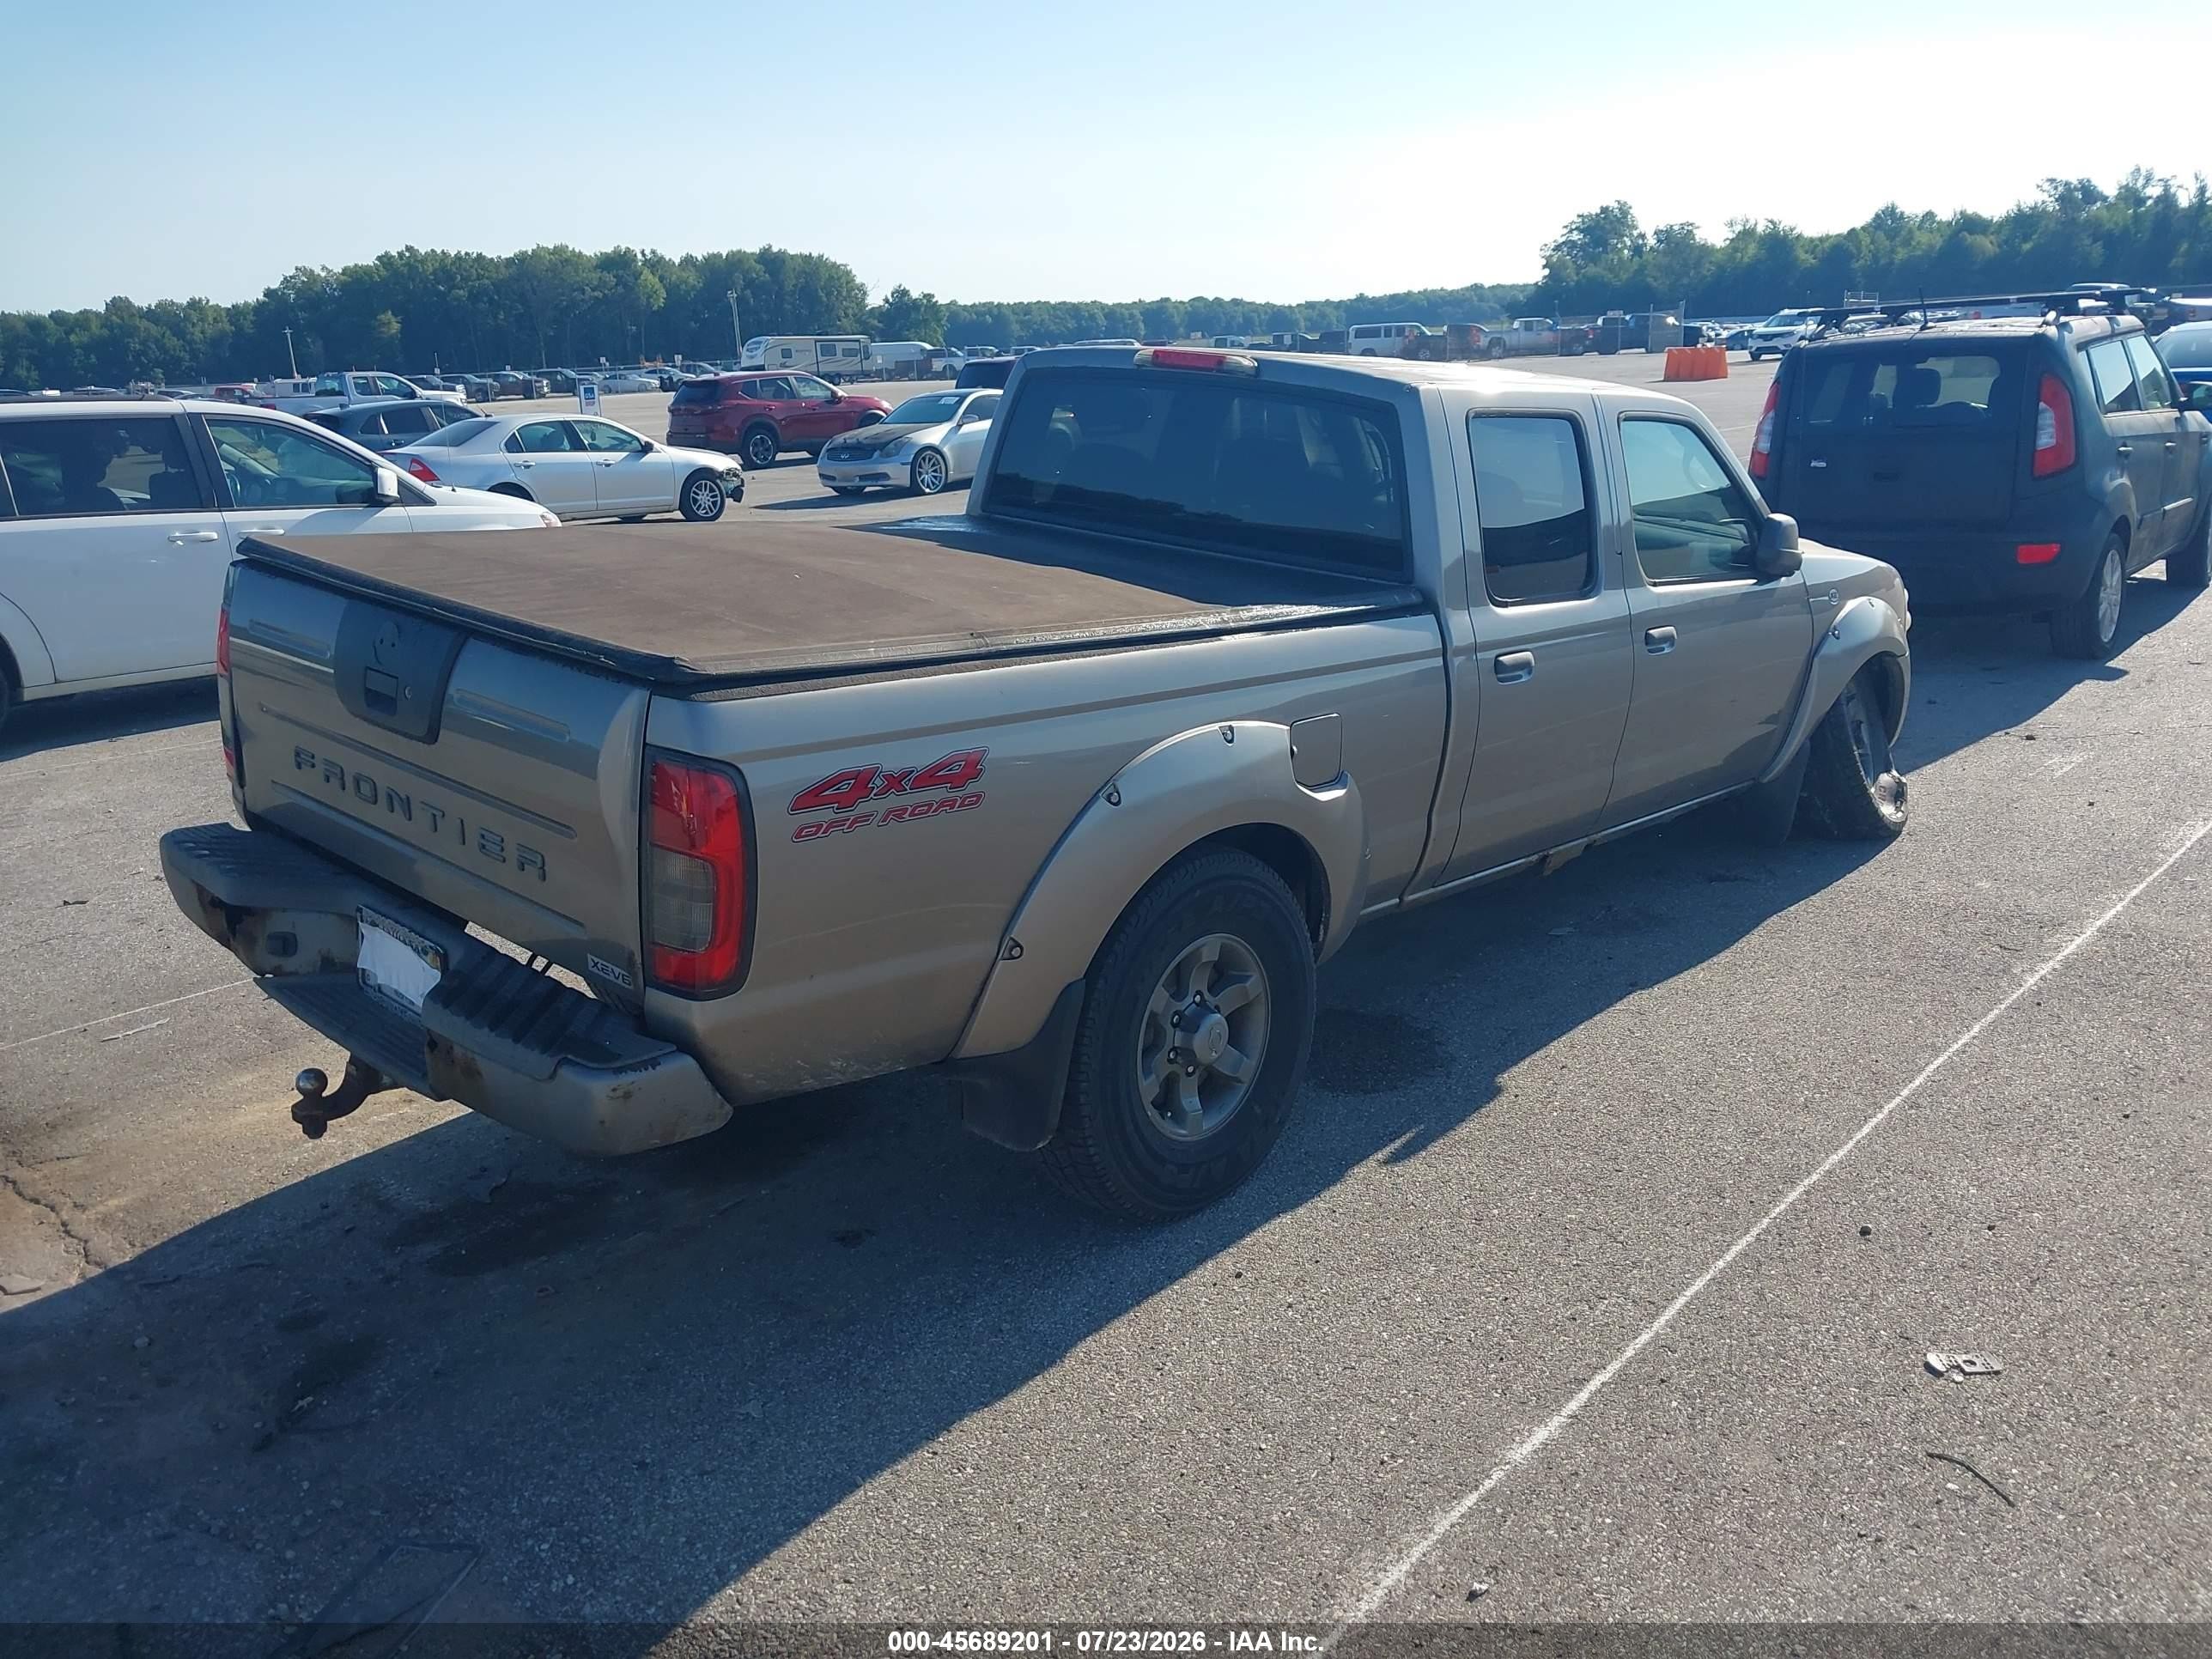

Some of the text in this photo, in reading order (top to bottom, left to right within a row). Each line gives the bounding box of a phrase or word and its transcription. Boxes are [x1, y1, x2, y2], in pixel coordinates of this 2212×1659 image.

[294, 745, 547, 882] FRONTIER
[787, 745, 989, 815] 4x4
[791, 792, 986, 843] OFF ROAD
